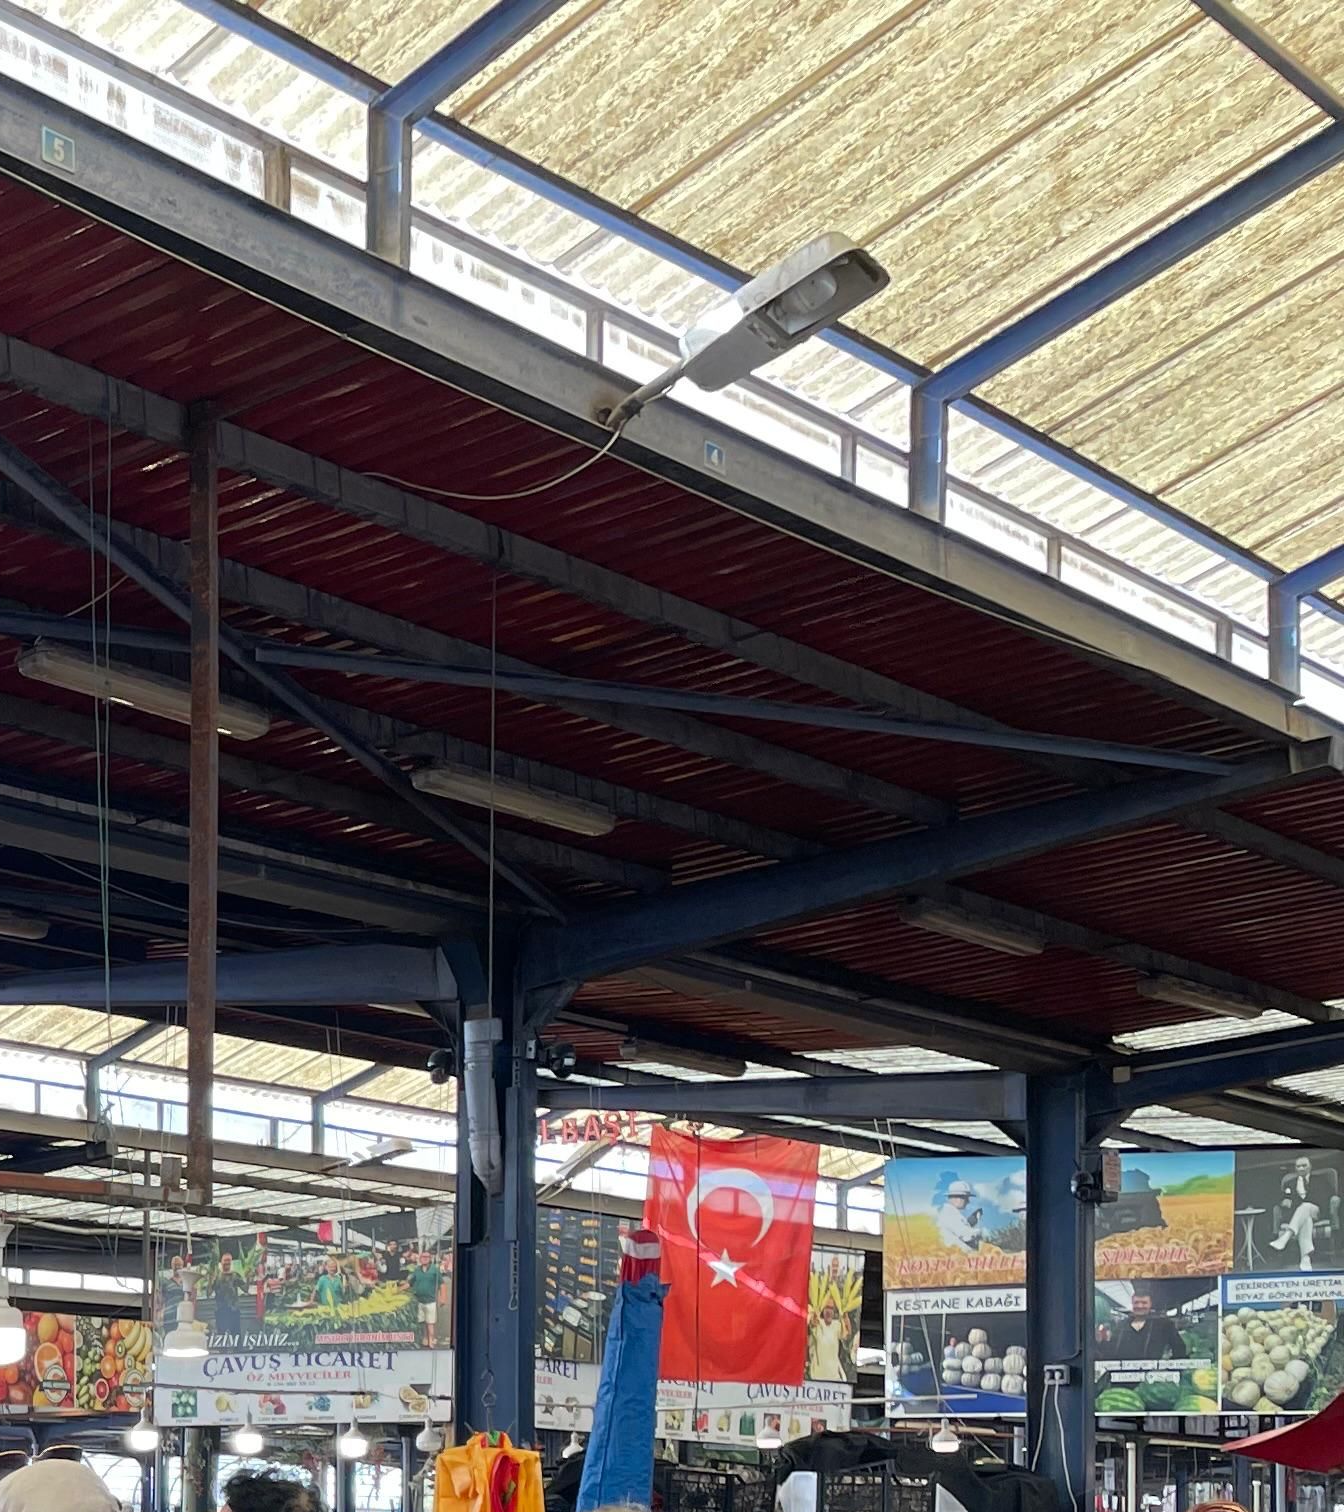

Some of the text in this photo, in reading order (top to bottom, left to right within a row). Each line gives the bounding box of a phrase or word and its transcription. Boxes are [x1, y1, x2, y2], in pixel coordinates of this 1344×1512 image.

[53, 137, 65, 162] 5
[895, 1293, 1023, 1312] KESTANE KABAĞI
[1235, 1293, 1265, 1301] BEYAZ
[1268, 1290, 1303, 1300] GÖNEN
[207, 1331, 240, 1349] İZİM
[203, 1352, 281, 1382] ÇAVUŞ
[246, 1371, 265, 1382] ÖZ
